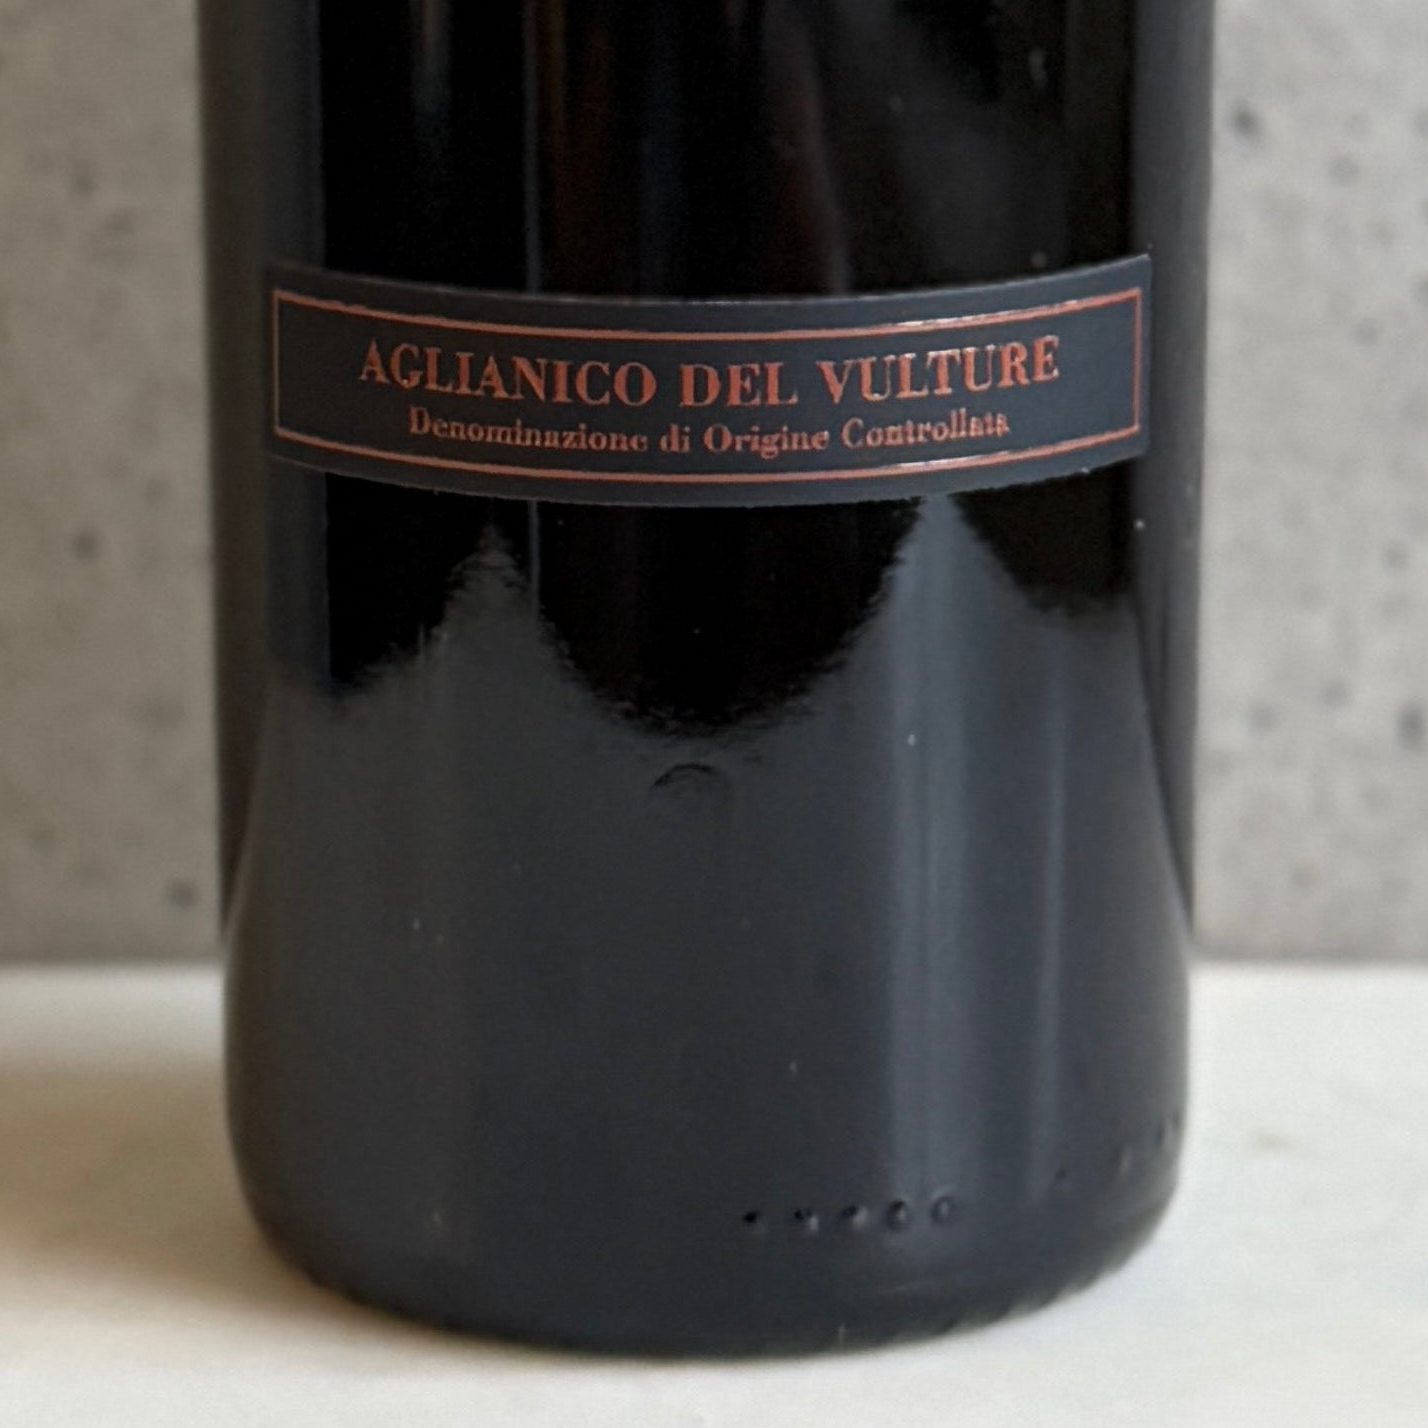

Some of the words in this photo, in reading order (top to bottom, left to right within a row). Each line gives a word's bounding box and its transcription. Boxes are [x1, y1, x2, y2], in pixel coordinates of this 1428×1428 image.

[358, 338, 658, 406] AGLIANICO
[678, 358, 799, 409] DEL
[815, 334, 1062, 406] VULTURE
[409, 408, 648, 452] Denominazione
[659, 421, 691, 454] di
[703, 424, 830, 461] Origine
[840, 406, 1011, 449] Controllata
